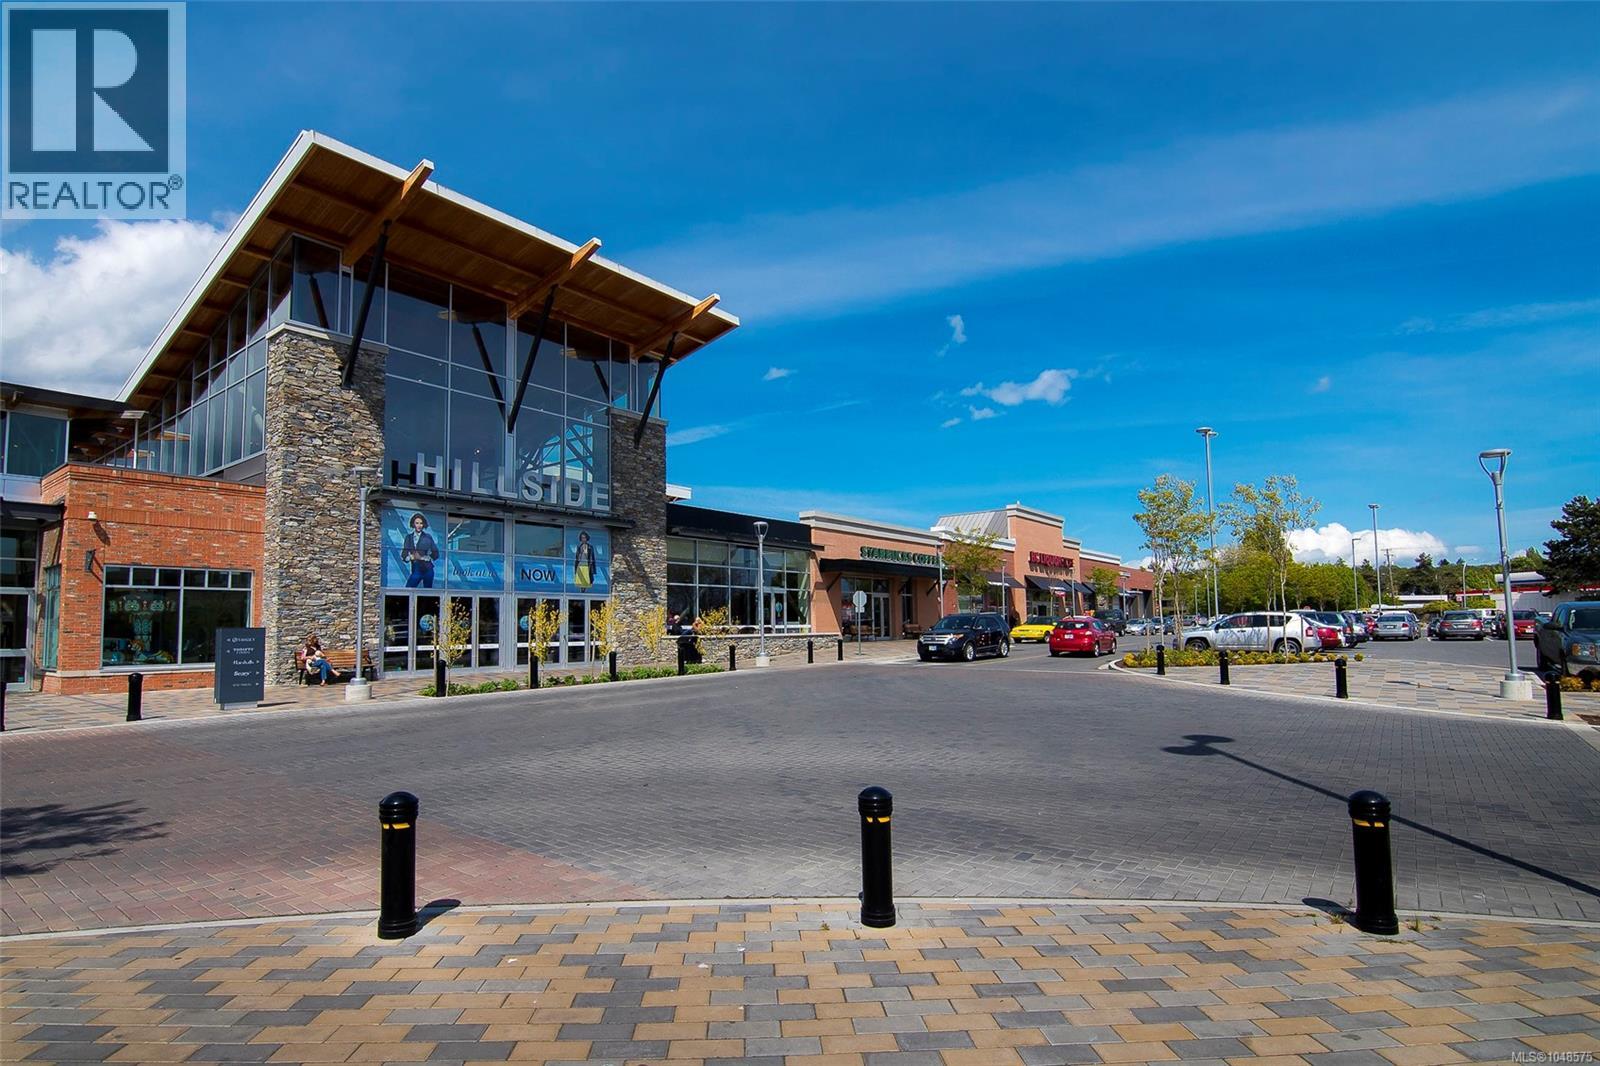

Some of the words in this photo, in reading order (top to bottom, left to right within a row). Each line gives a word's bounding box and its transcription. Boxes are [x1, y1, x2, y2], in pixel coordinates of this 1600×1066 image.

[416, 452, 610, 511] HILLSIDE
[860, 546, 913, 564] STARBUCKS
[521, 568, 556, 582] NOW
